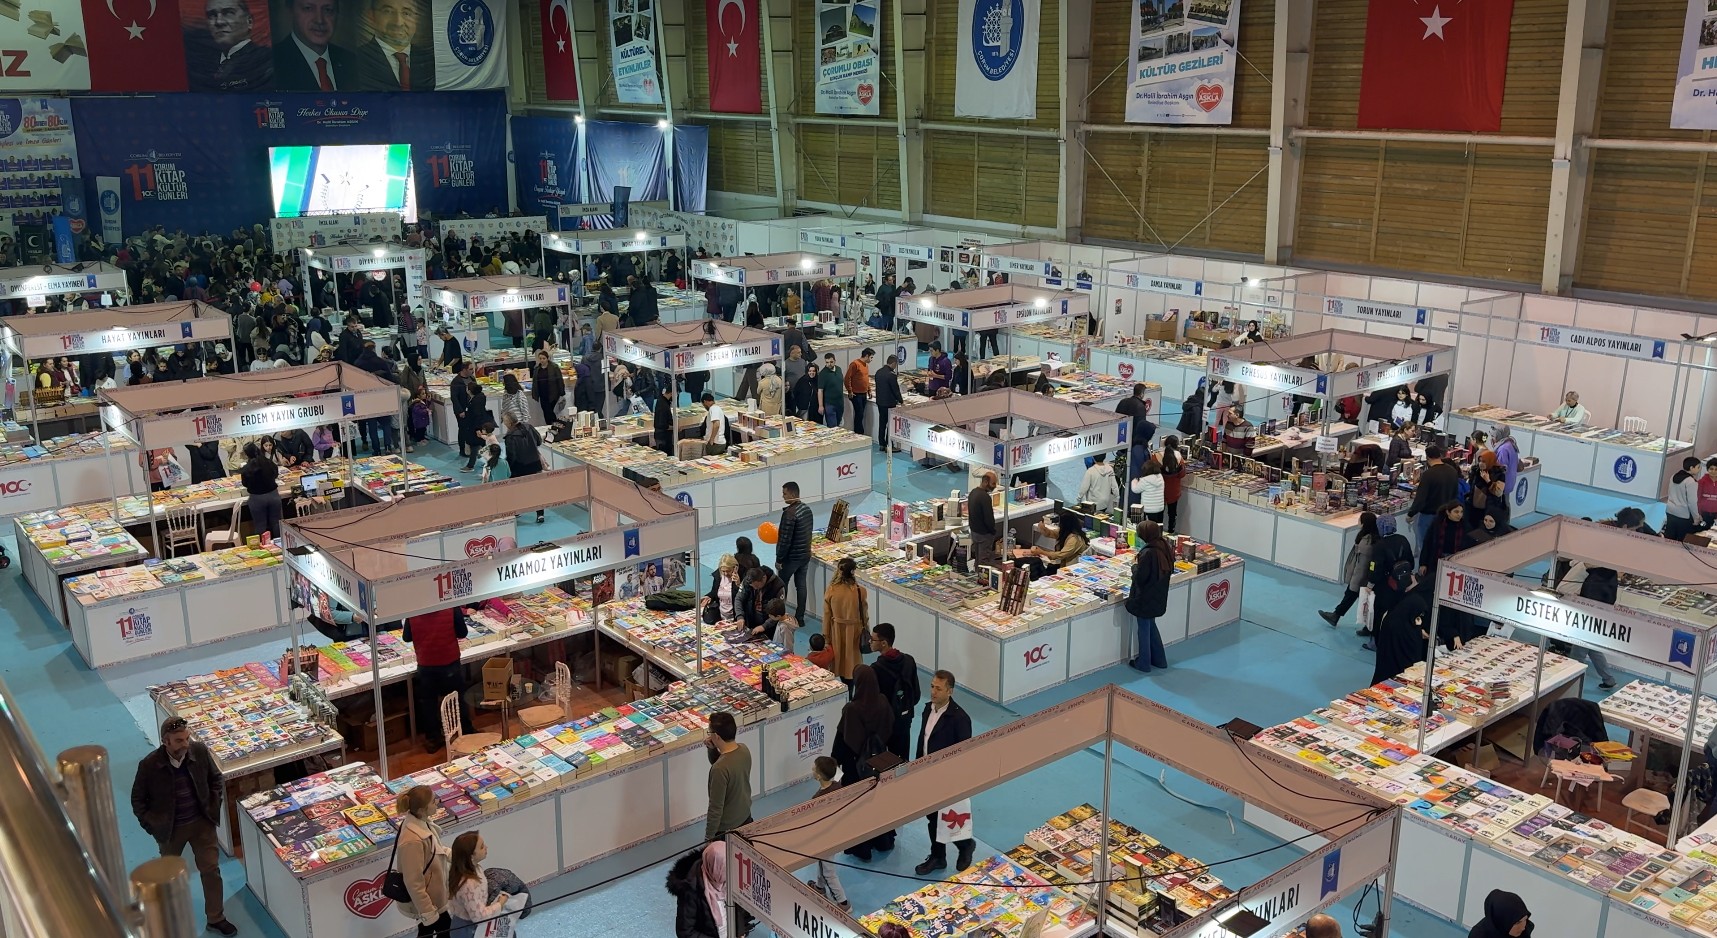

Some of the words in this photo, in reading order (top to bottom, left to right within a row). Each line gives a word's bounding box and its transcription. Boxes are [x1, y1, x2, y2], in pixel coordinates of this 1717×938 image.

[620, 45, 646, 60] KÜLTÜREL
[823, 63, 851, 78] ÇORUMLU
[853, 58, 873, 70] OBASI
[1140, 62, 1176, 79] KÜLTÜR
[1179, 52, 1223, 72] GEZİLERİ
[1157, 91, 1178, 99] İbrahim
[1179, 92, 1194, 101] Aşgın
[1693, 89, 1705, 97] Dr.
[427, 155, 450, 188] 11
[450, 161, 474, 171] KİTAP
[125, 164, 156, 201] 11
[155, 169, 186, 183] KİTAP
[451, 171, 475, 181] KÜLTÜR
[156, 181, 188, 192] KÜLTÜR
[158, 190, 189, 201] GÜNLERİ
[62, 278, 85, 289] YAYINEVİ
[1164, 280, 1183, 290] YAYINLARI
[932, 309, 955, 321] YAYINLARI
[1357, 305, 1374, 315] TORUN
[1375, 307, 1402, 319] YAYINLARI
[101, 334, 126, 343] HAYAT
[128, 329, 166, 341] YAYINLARI
[1540, 327, 1549, 341] 11
[1570, 334, 1585, 344] CADI
[1586, 337, 1606, 348] ALPOS
[1607, 340, 1642, 353] YAYINLARI
[731, 346, 761, 359] YAYINLARI
[1211, 357, 1219, 373] 11
[1241, 366, 1268, 380] EPHESUS
[1270, 370, 1303, 387] YAYINLARI
[241, 413, 268, 426] ERDEM
[271, 409, 295, 422] YAYIN
[297, 405, 324, 418] GRUBU
[192, 416, 206, 436] 11
[927, 430, 938, 442] REN
[957, 439, 975, 454] YAYIN
[1048, 443, 1060, 455] REN
[1062, 436, 1082, 452] KİTAP
[1084, 433, 1103, 448] YAYIN
[1011, 446, 1021, 465] 11
[325, 487, 342, 496] ZOOM
[497, 557, 547, 581] YAKAMOZ
[551, 545, 602, 570] YAYINLARI
[452, 572, 472, 584] KİTAP
[453, 580, 472, 591] KÜLTÜR
[1447, 571, 1464, 597] 11
[433, 573, 452, 599] 11
[1464, 579, 1484, 593] KİTAP
[1463, 590, 1483, 600] KÜLTÜR
[116, 616, 133, 638] 11
[1516, 596, 1559, 623] DESTEK
[1565, 610, 1632, 643] YAYINLARI
[795, 726, 809, 752] 11
[1135, 745, 1157, 759] SARAY
[1206, 778, 1230, 793] SARAY
[791, 803, 816, 816] SARAY
[1284, 814, 1310, 830] SARAY
[735, 852, 751, 891] 11
